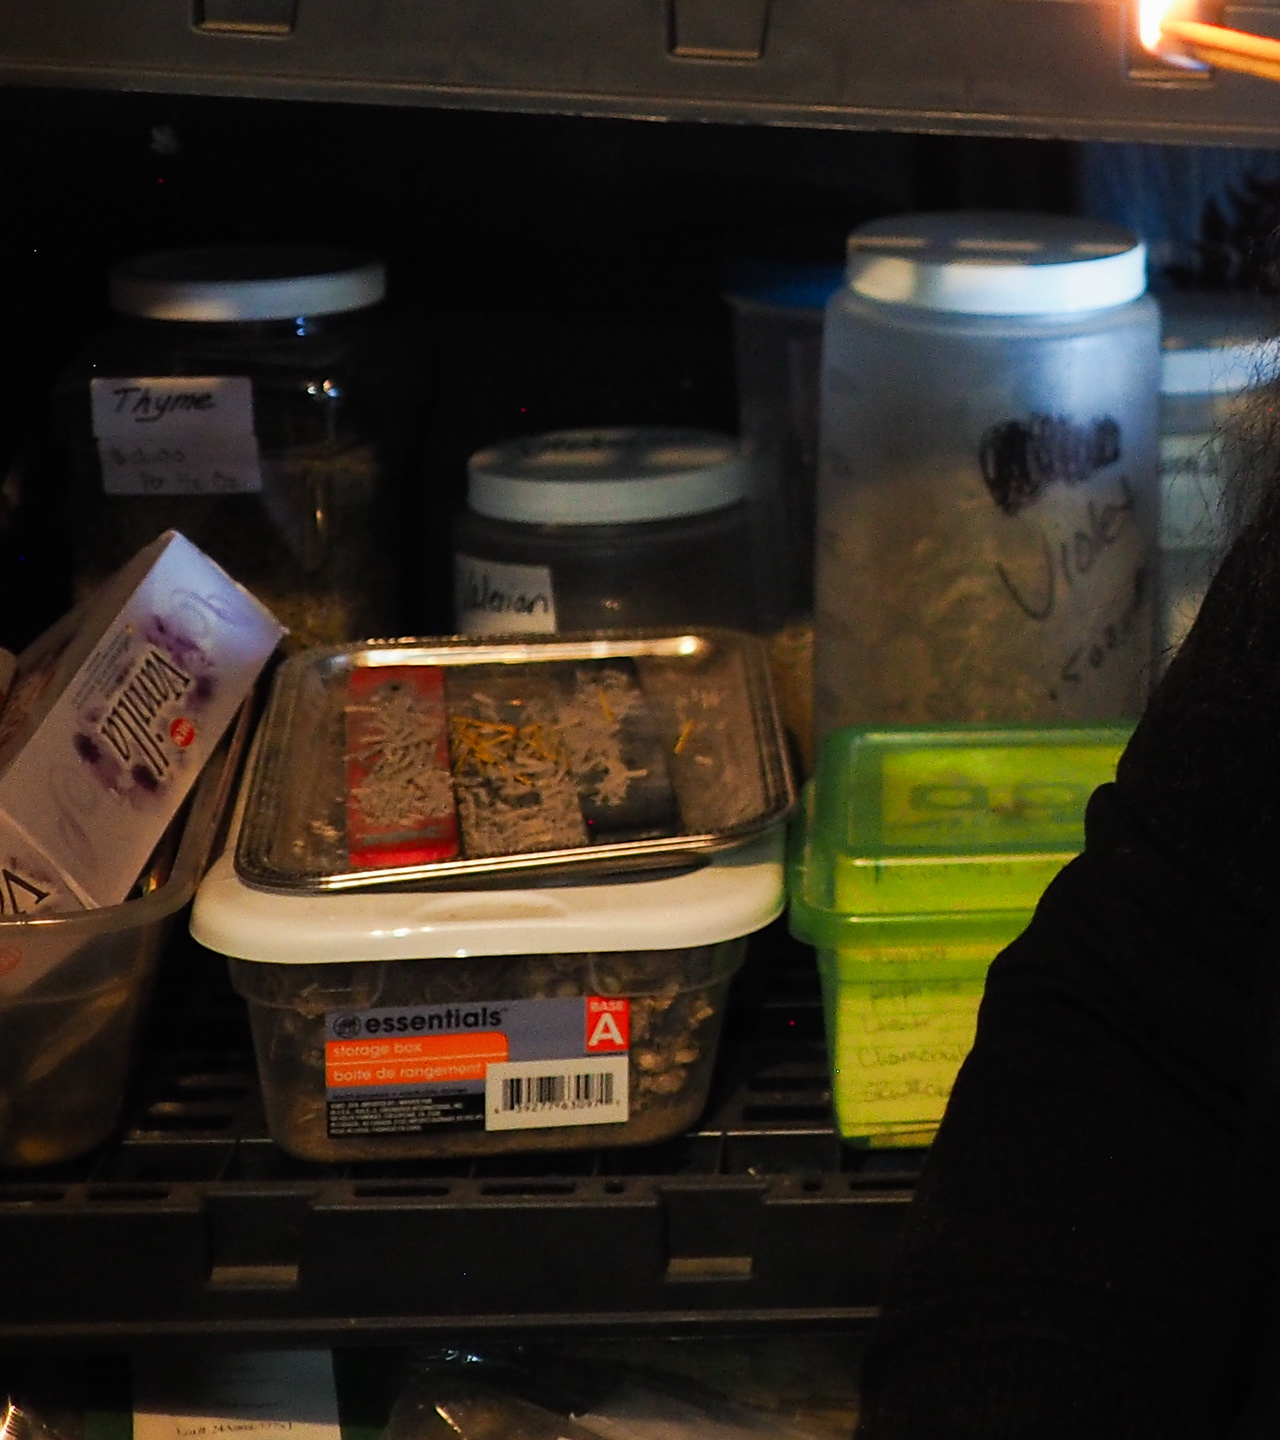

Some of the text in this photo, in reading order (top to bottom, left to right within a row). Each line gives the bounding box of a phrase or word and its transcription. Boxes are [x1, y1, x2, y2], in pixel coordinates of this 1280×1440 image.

[113, 387, 217, 423] Thyme
[100, 649, 191, 778] Vanilla
[364, 1008, 502, 1035] essentials
[588, 1013, 625, 1047] A
[333, 1042, 422, 1058] storage box
[375, 1067, 396, 1080] de
[400, 1062, 482, 1080] rangement
